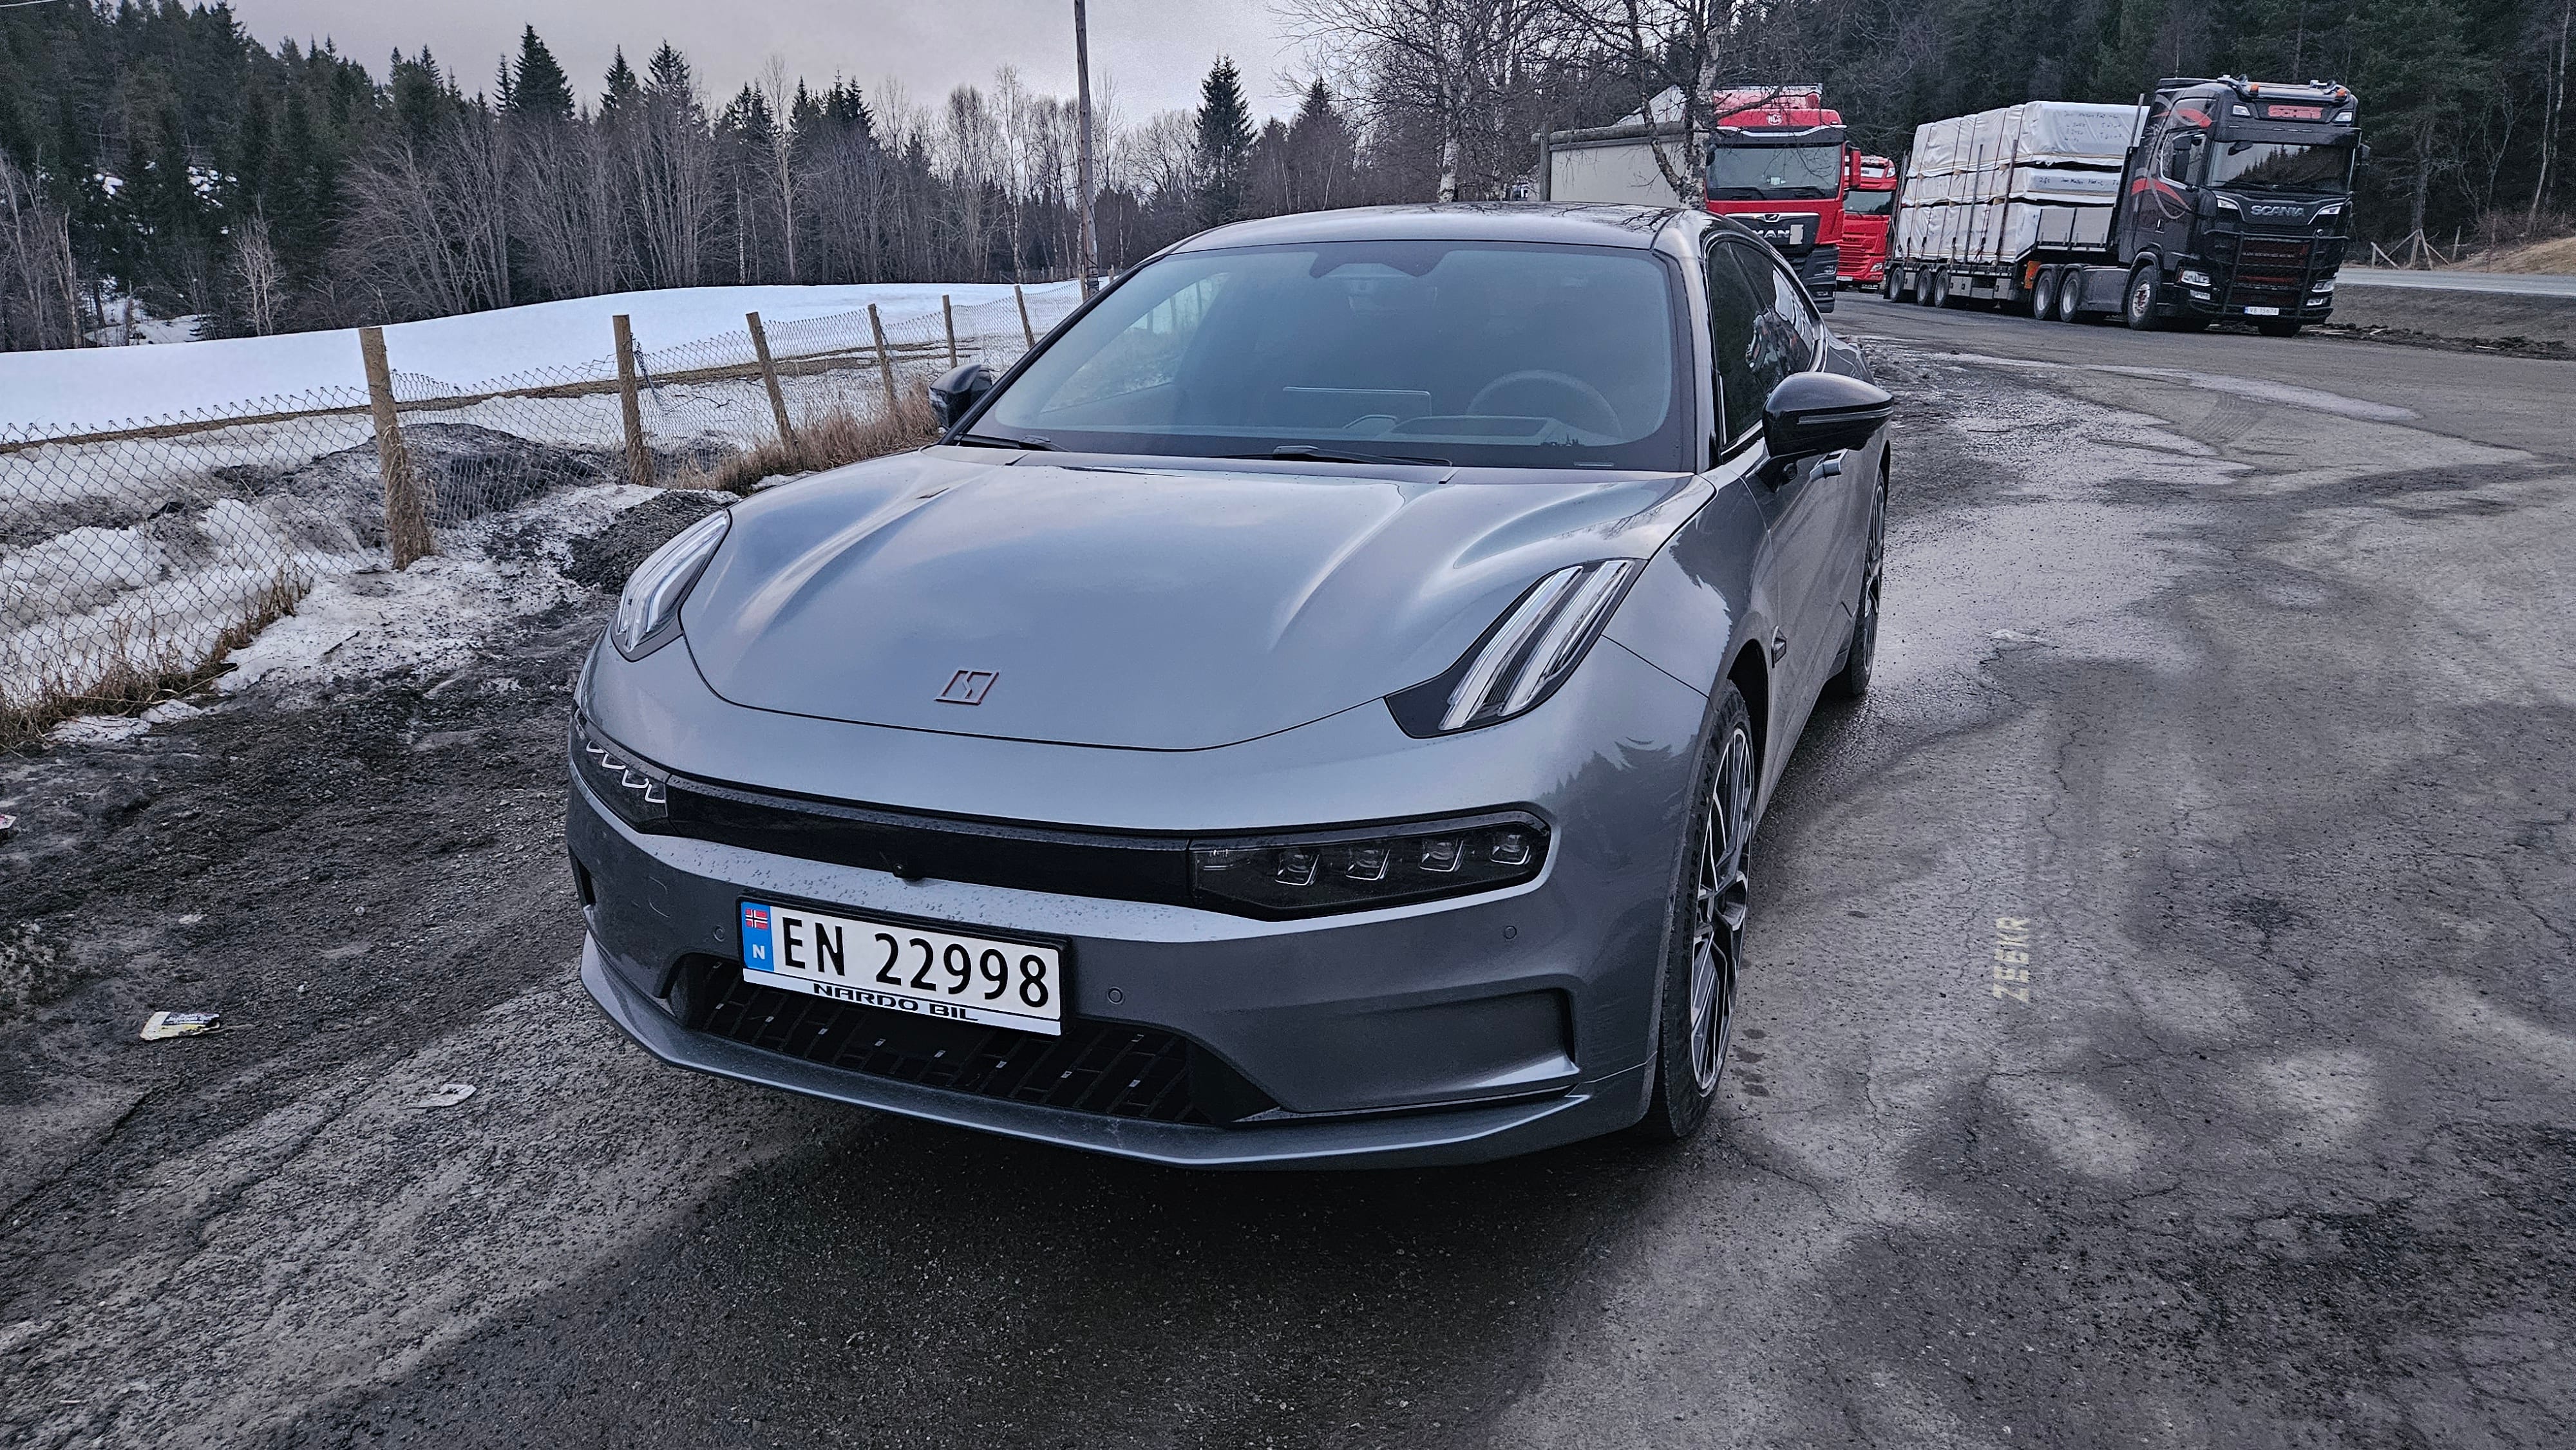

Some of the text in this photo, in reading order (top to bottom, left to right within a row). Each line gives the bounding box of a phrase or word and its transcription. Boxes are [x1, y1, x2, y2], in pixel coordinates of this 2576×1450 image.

[2251, 205, 2305, 216] SCANIA
[752, 944, 765, 959] N
[782, 916, 1049, 1008] EN 22998
[1993, 917, 2030, 1003] ZEEKR
[813, 983, 979, 1021] NARDO BIL
